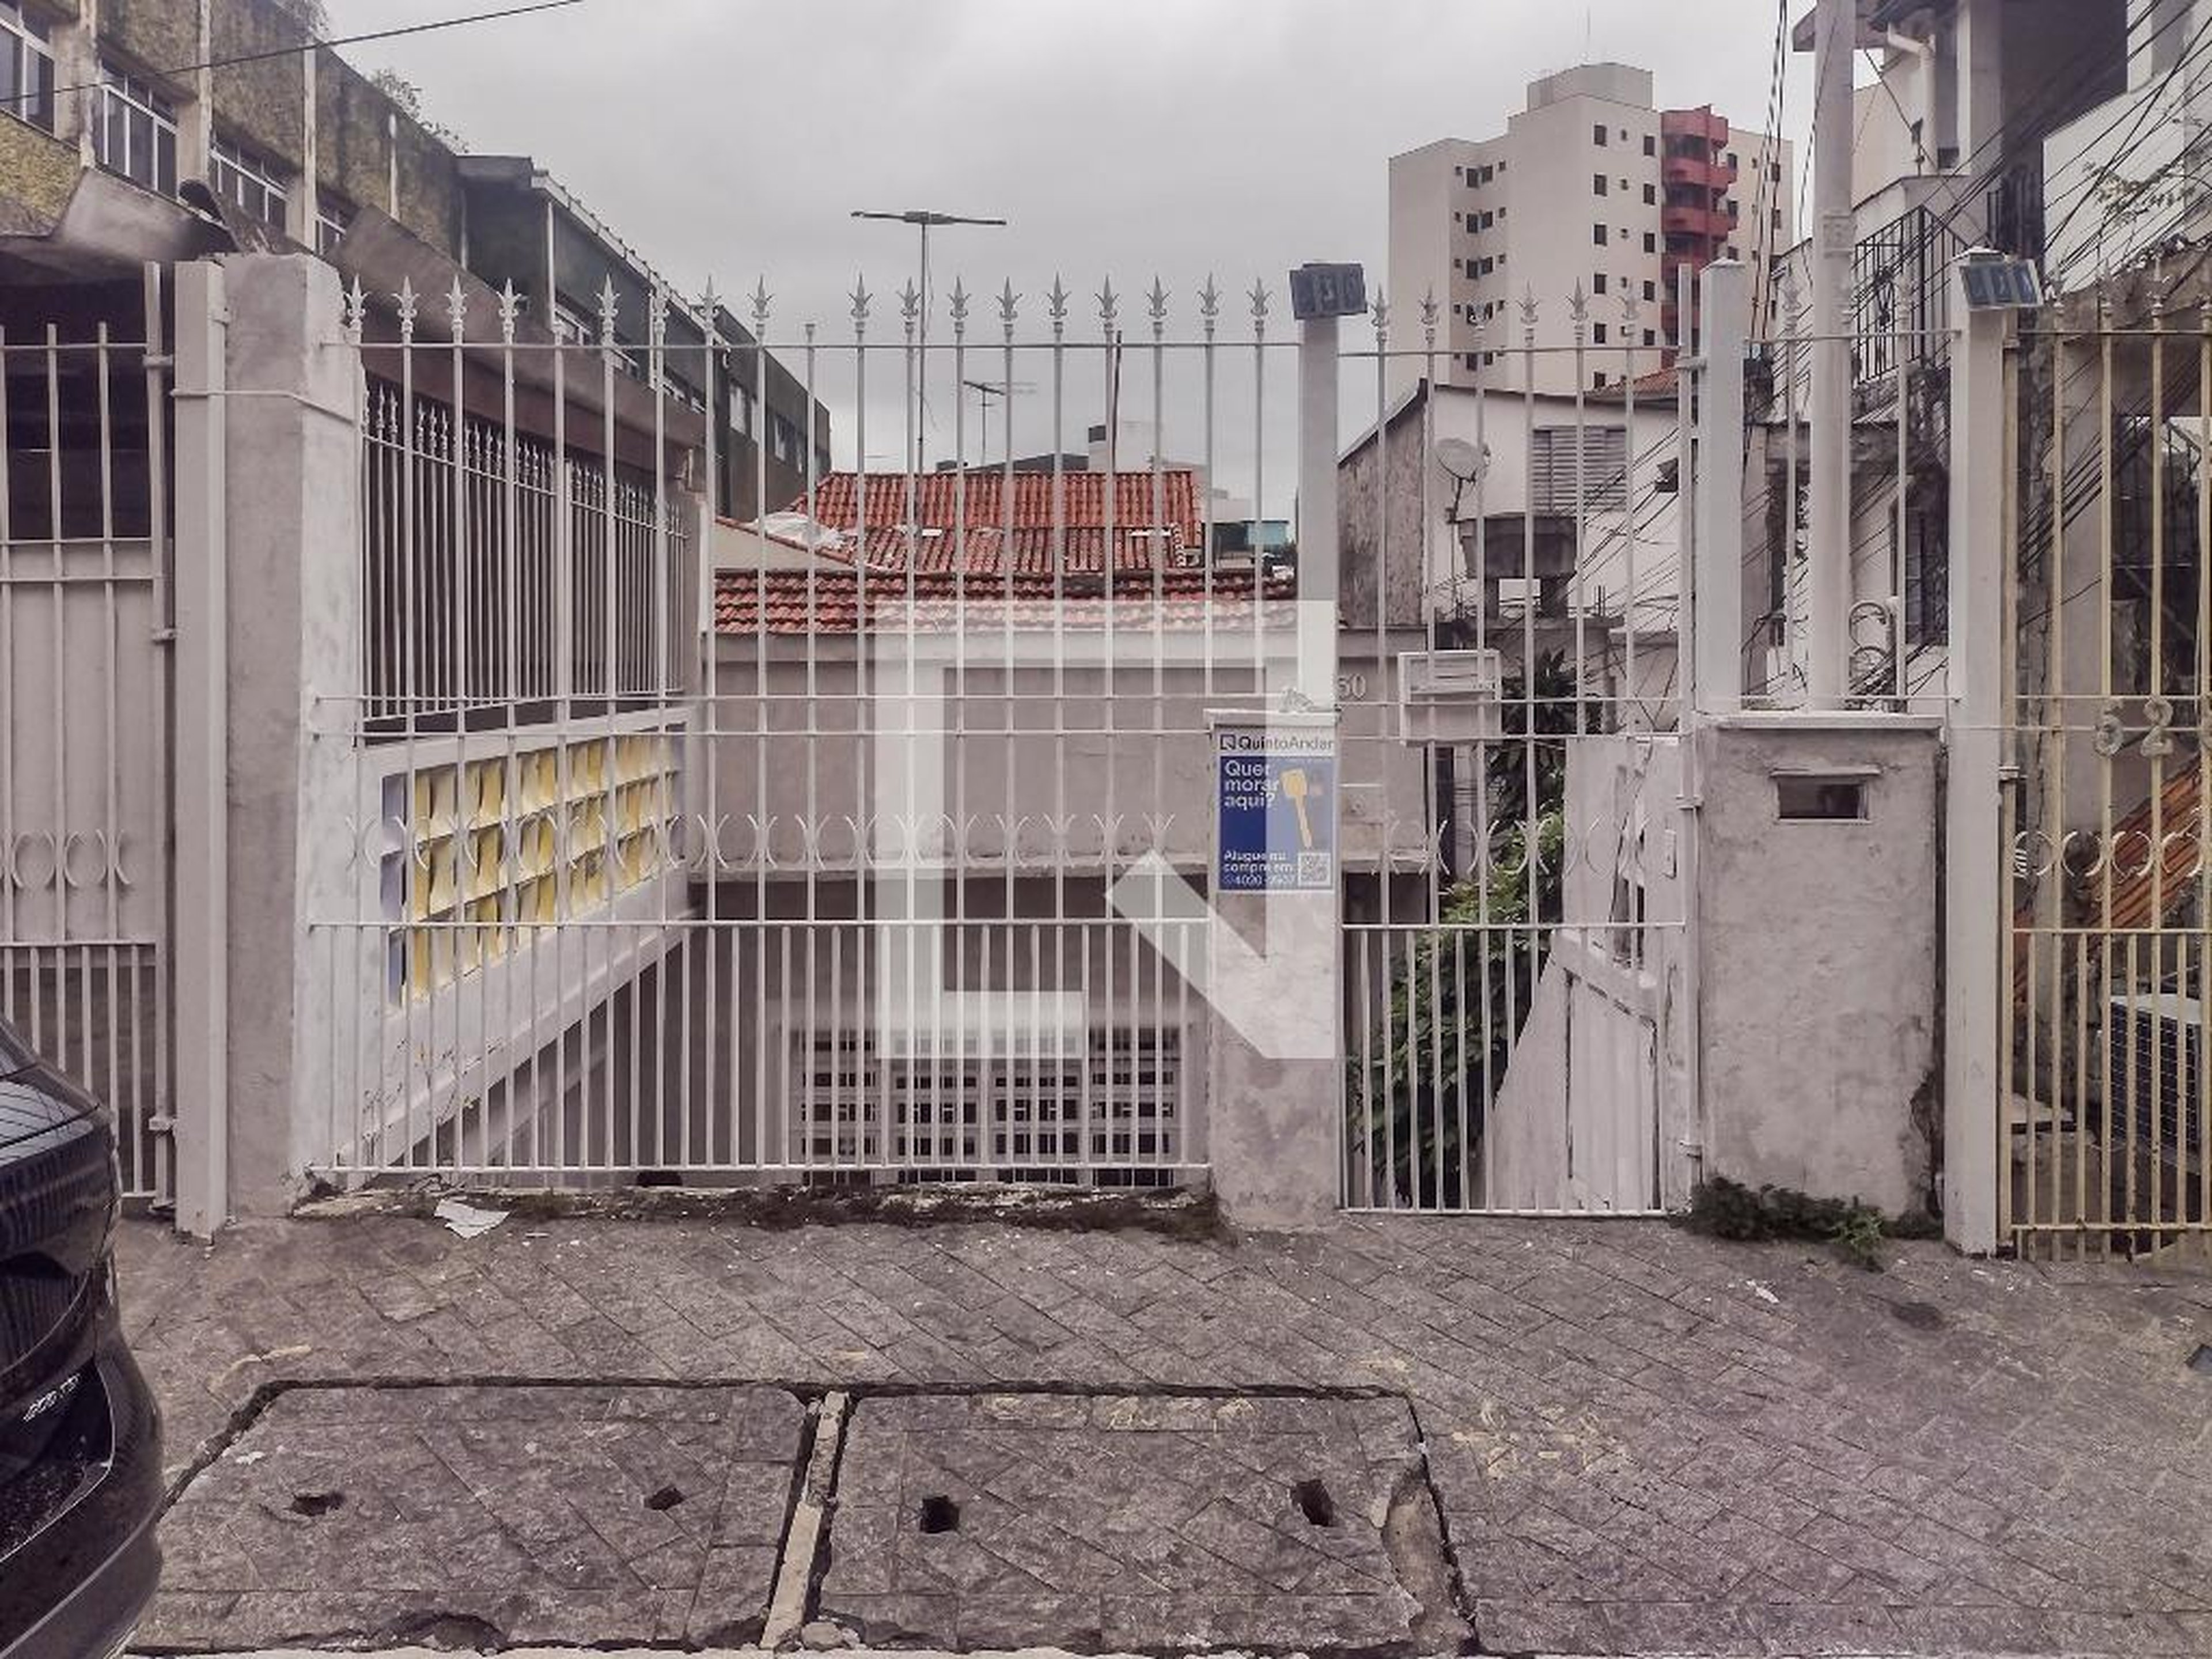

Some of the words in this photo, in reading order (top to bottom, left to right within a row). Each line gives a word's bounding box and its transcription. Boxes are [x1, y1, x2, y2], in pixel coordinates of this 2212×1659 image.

[1239, 735, 1334, 751] QuintoAndar
[1225, 759, 1270, 777] Quer
[1225, 779, 1280, 792] morar
[1224, 792, 1275, 811] aqui?
